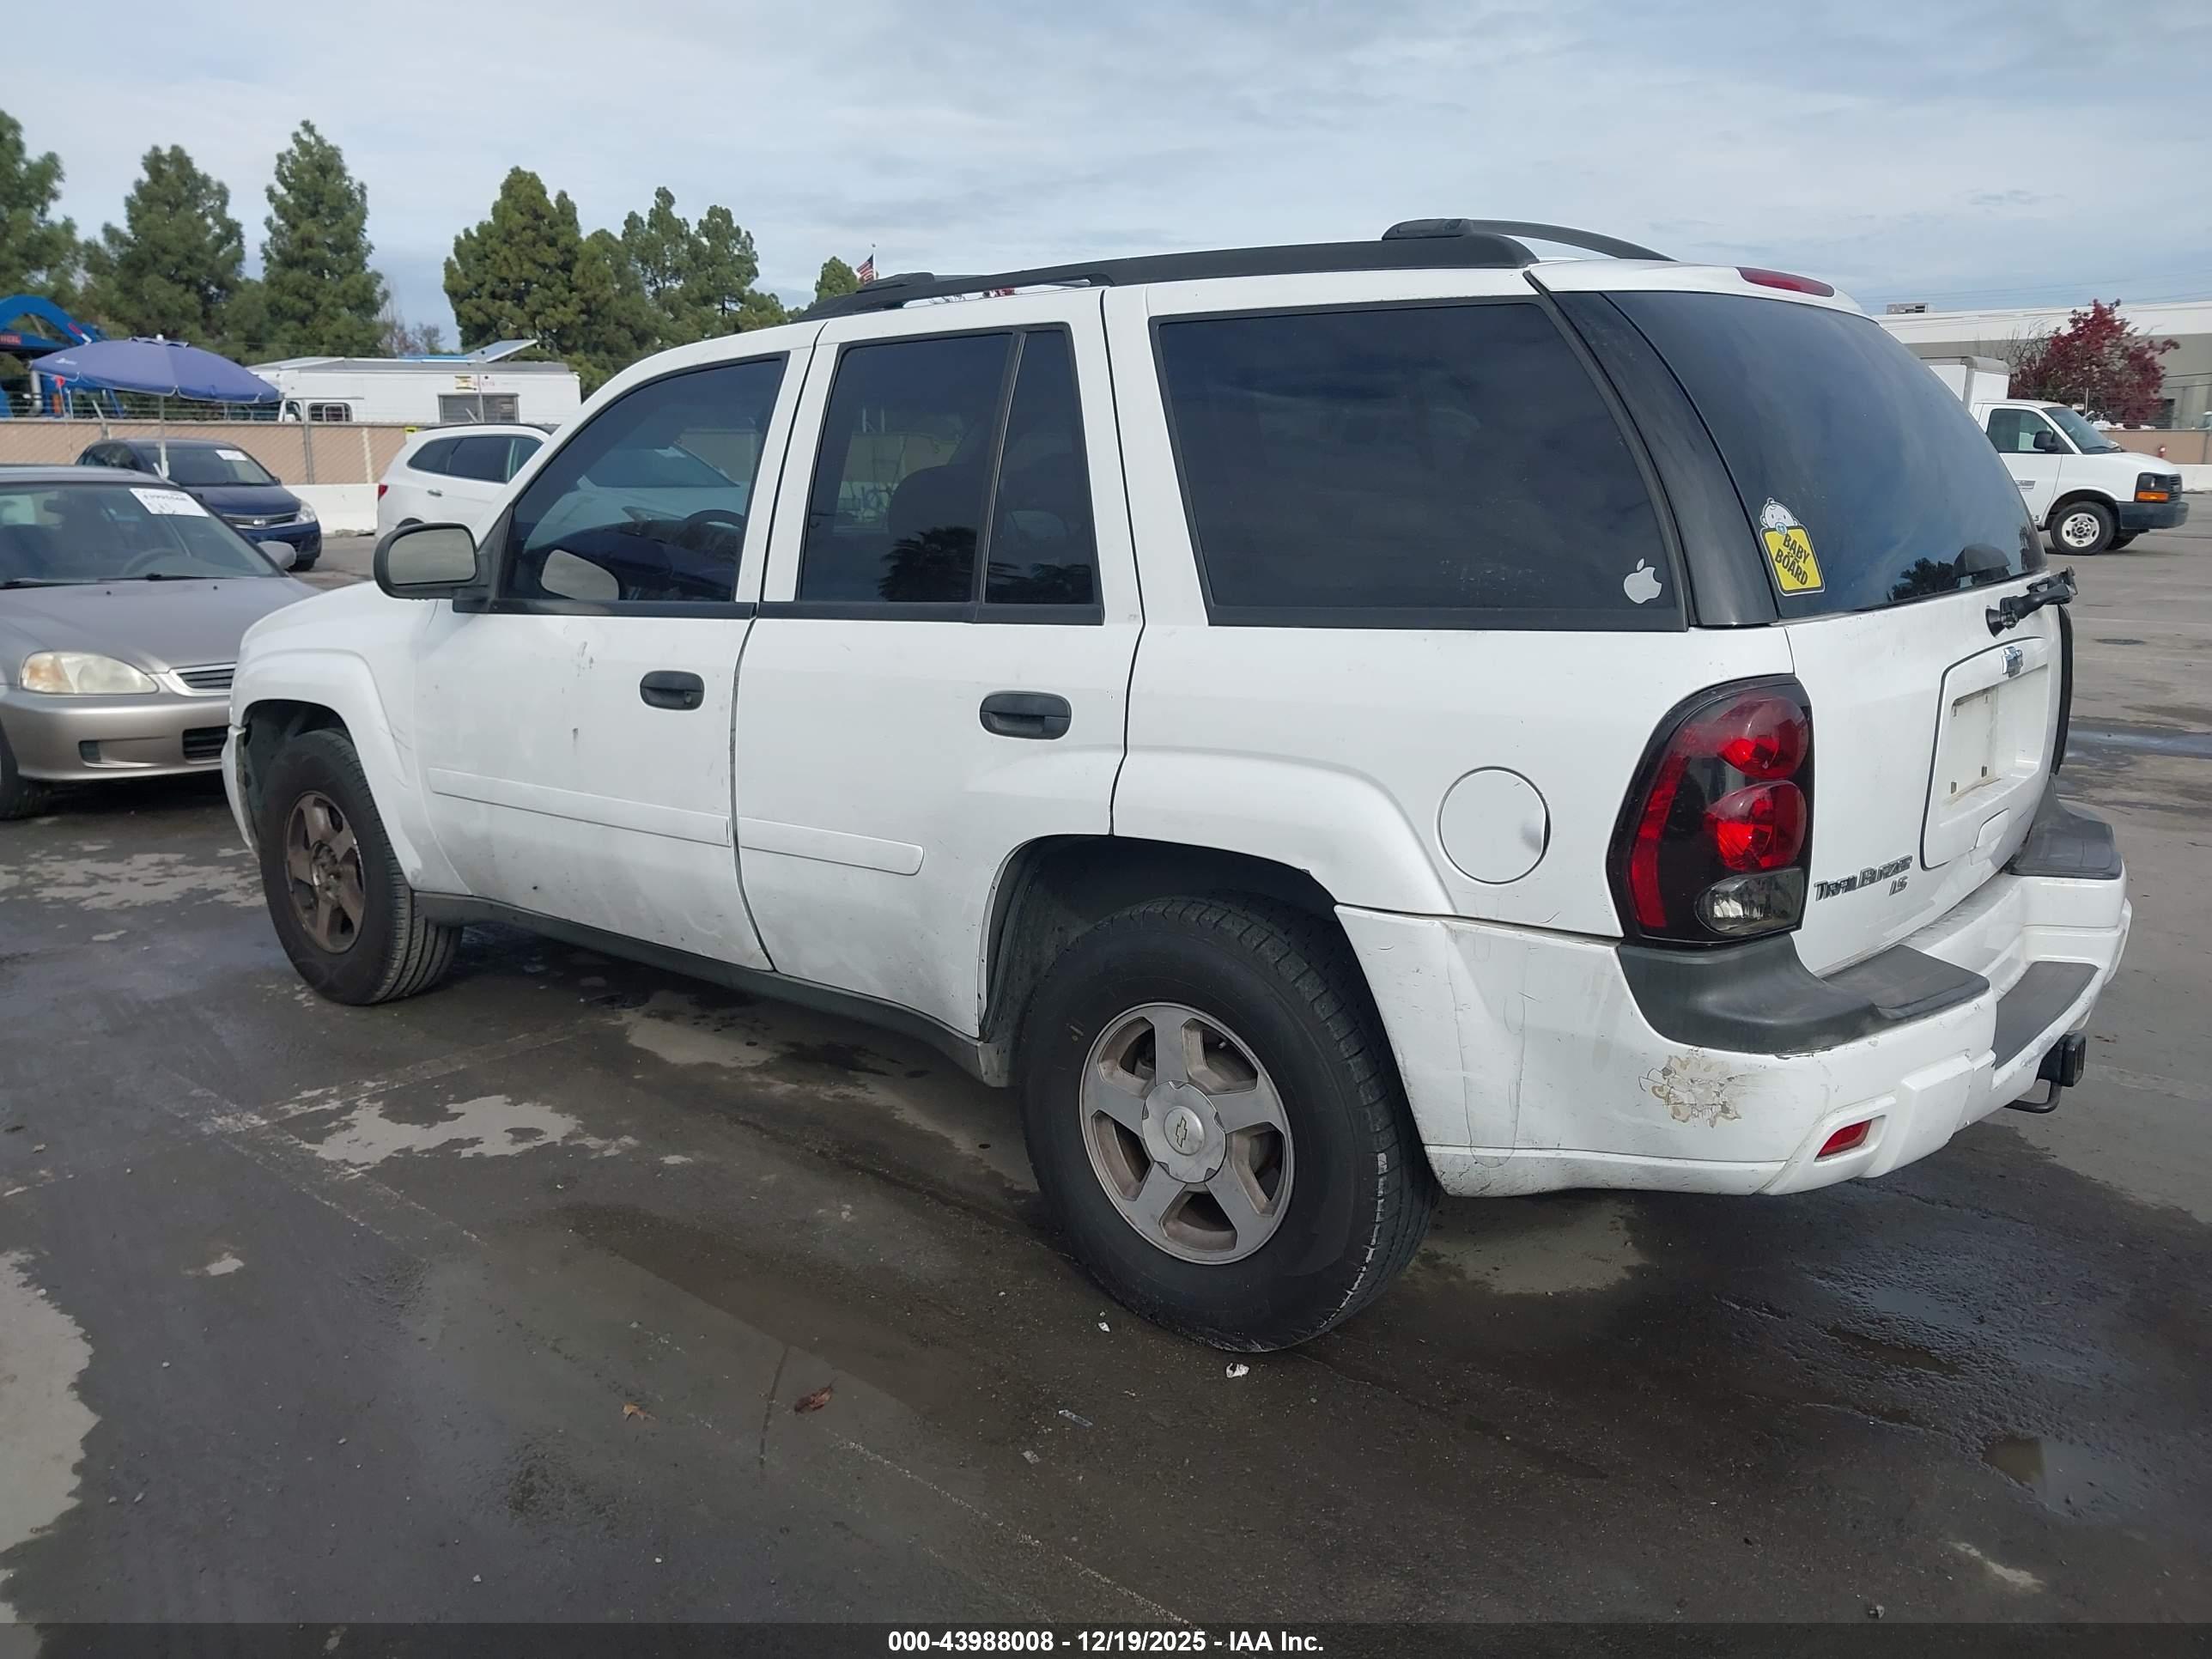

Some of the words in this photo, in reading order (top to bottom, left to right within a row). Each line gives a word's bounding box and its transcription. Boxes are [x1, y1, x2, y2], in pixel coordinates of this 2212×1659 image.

[1783, 534, 1810, 564] BABY
[1775, 548, 1808, 586] BOARD
[1889, 876, 1908, 896] LS
